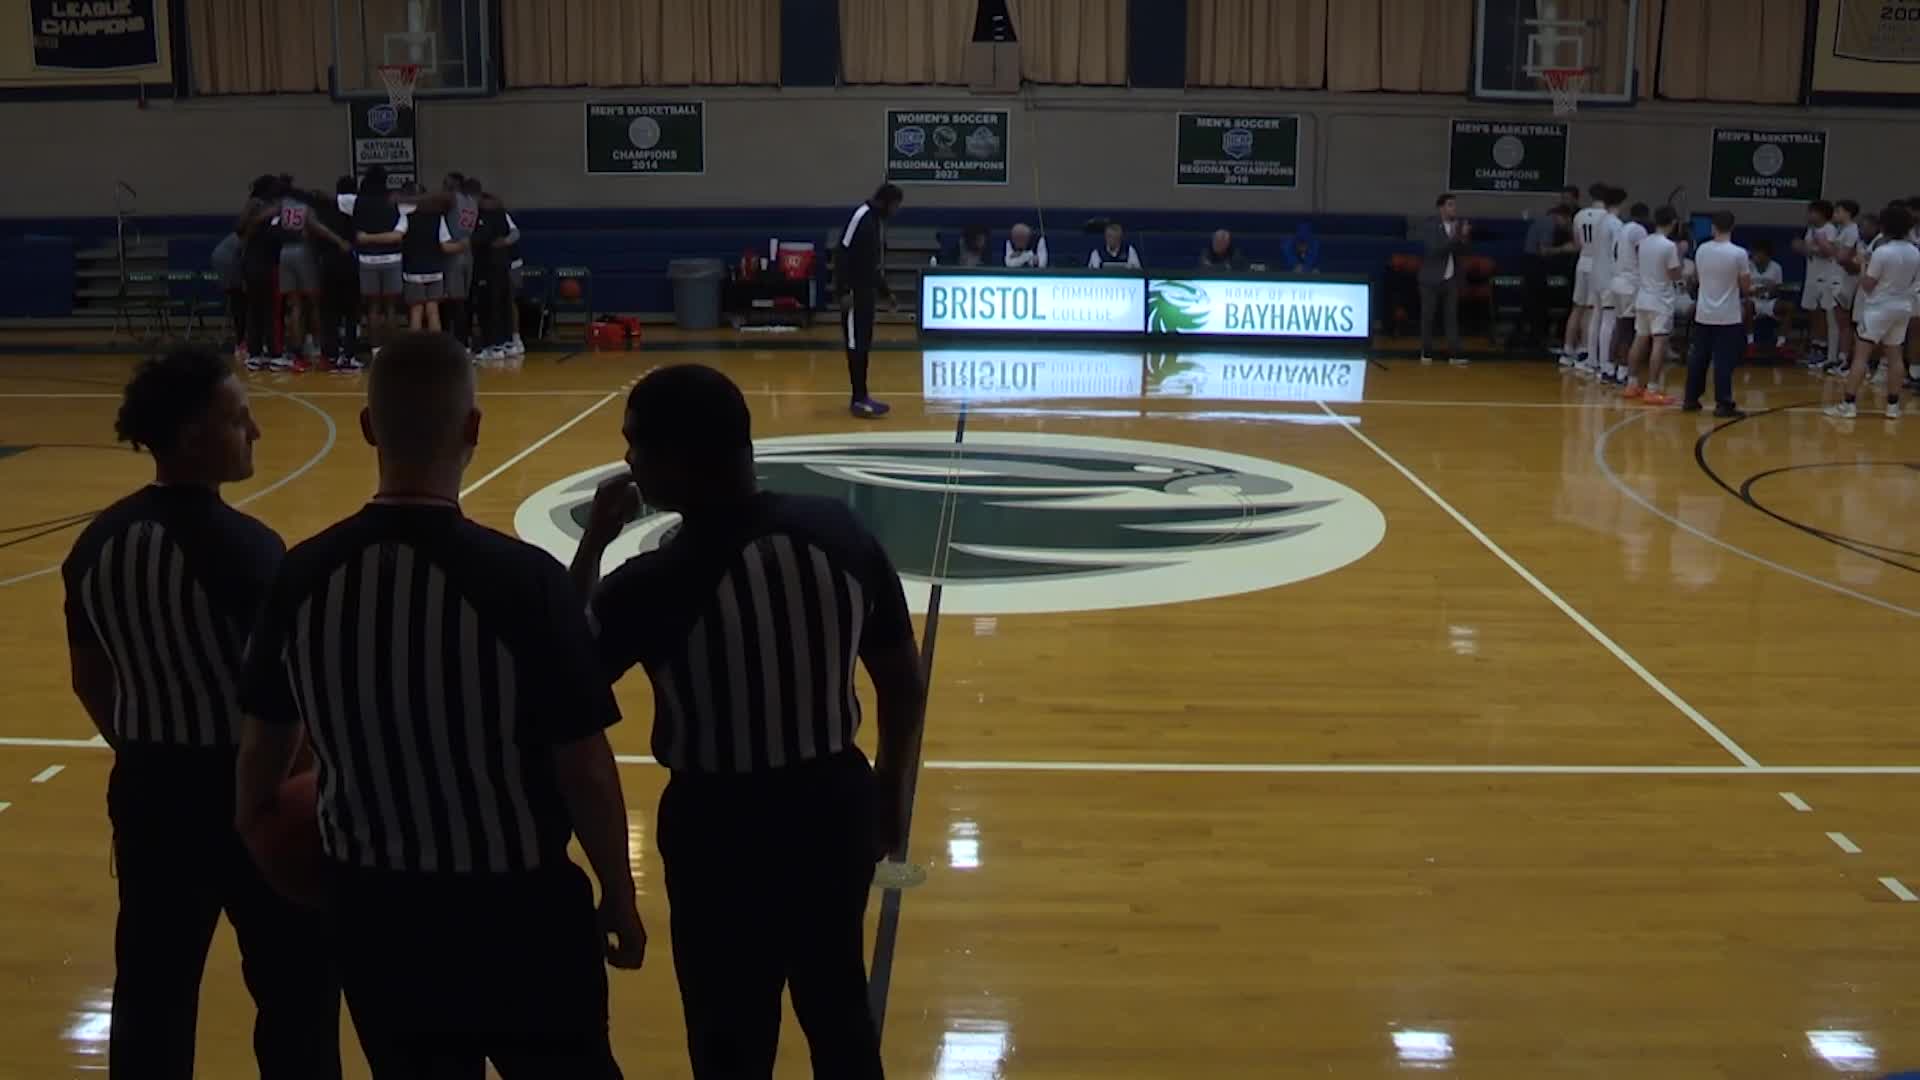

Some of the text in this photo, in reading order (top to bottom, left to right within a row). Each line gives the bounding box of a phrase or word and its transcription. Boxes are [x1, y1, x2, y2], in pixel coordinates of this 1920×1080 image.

[51, 0, 134, 17] LEAGUE
[40, 16, 146, 36] CHAMPIONS
[590, 105, 697, 116] MEN'S BASKETBALL
[896, 113, 999, 125] WOMEN'S SOCCER
[1196, 117, 1281, 129] MEN'S SOCCER
[1455, 122, 1562, 136] MEN'S BASKETBALL
[1717, 131, 1822, 144] MEN'S BASKETBALL
[363, 141, 406, 151] NATIONAL
[360, 150, 410, 161] QUALIFIERS
[612, 149, 678, 160] CHAMPIONS
[889, 160, 1005, 170] REGIONAL CHAMPIONS
[1179, 164, 1295, 176] REGIONAL CHAMPIONS
[934, 170, 960, 179] 2022
[1475, 168, 1541, 180] CHAMPIONS
[1733, 176, 1799, 187] CHAMPIONS
[1582, 223, 1593, 243] 11
[1225, 287, 1312, 300] HOME OF THE
[932, 286, 1137, 320] BRISTOL COMMUNITY
[1052, 307, 1113, 321] COLLEGE
[1225, 303, 1354, 332] BAYHAWKS
